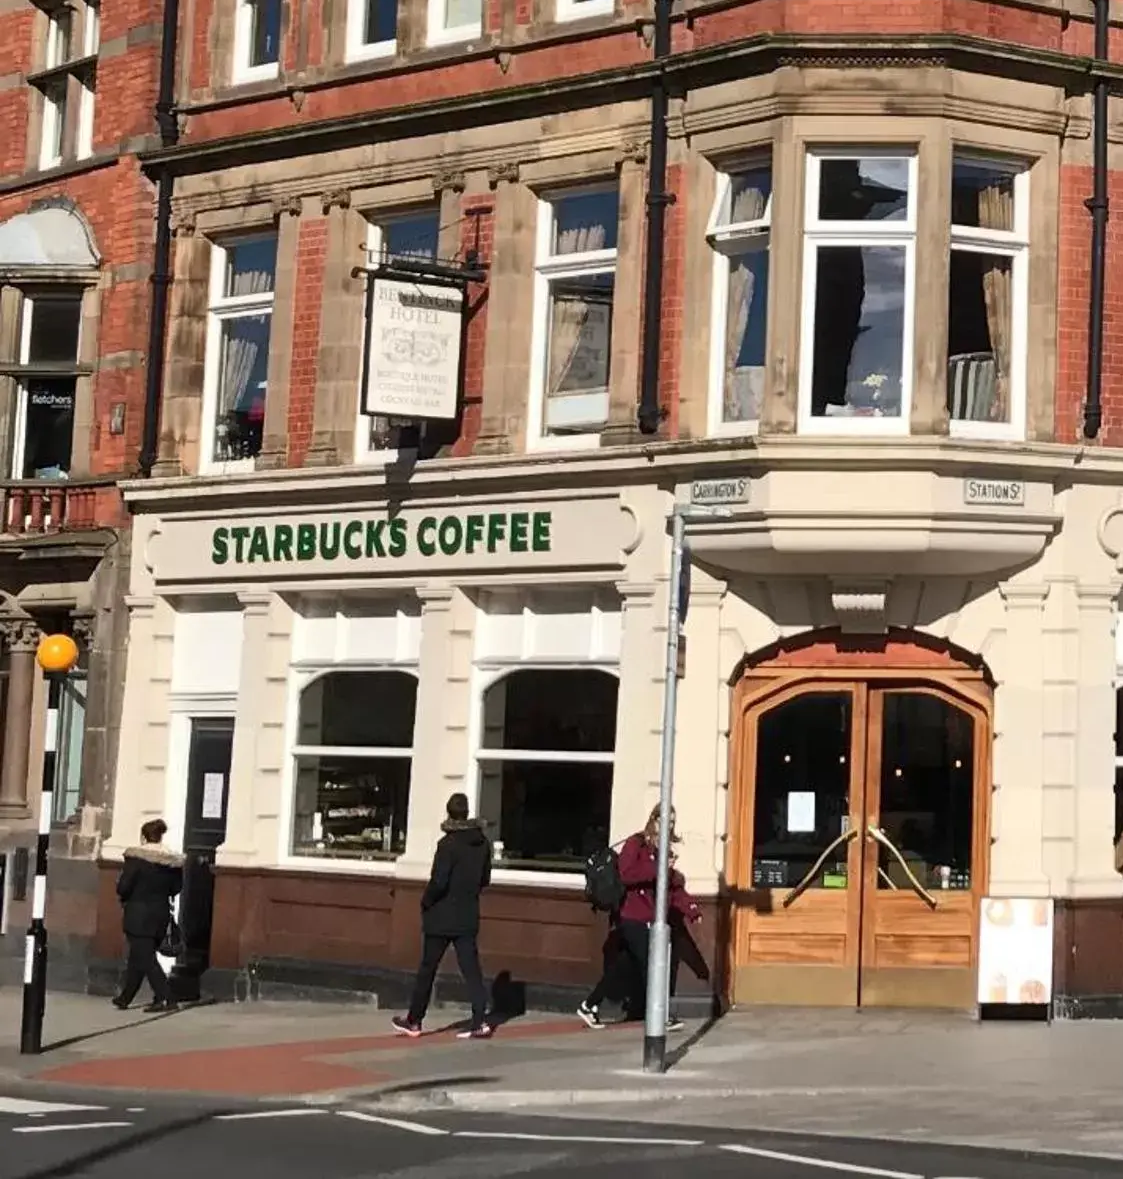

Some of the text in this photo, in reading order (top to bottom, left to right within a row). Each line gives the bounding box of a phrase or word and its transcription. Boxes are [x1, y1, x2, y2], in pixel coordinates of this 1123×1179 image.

[390, 306, 441, 325] HOTEL
[969, 481, 1009, 500] STATION
[211, 511, 553, 565] STARBUCKS COFFEE
